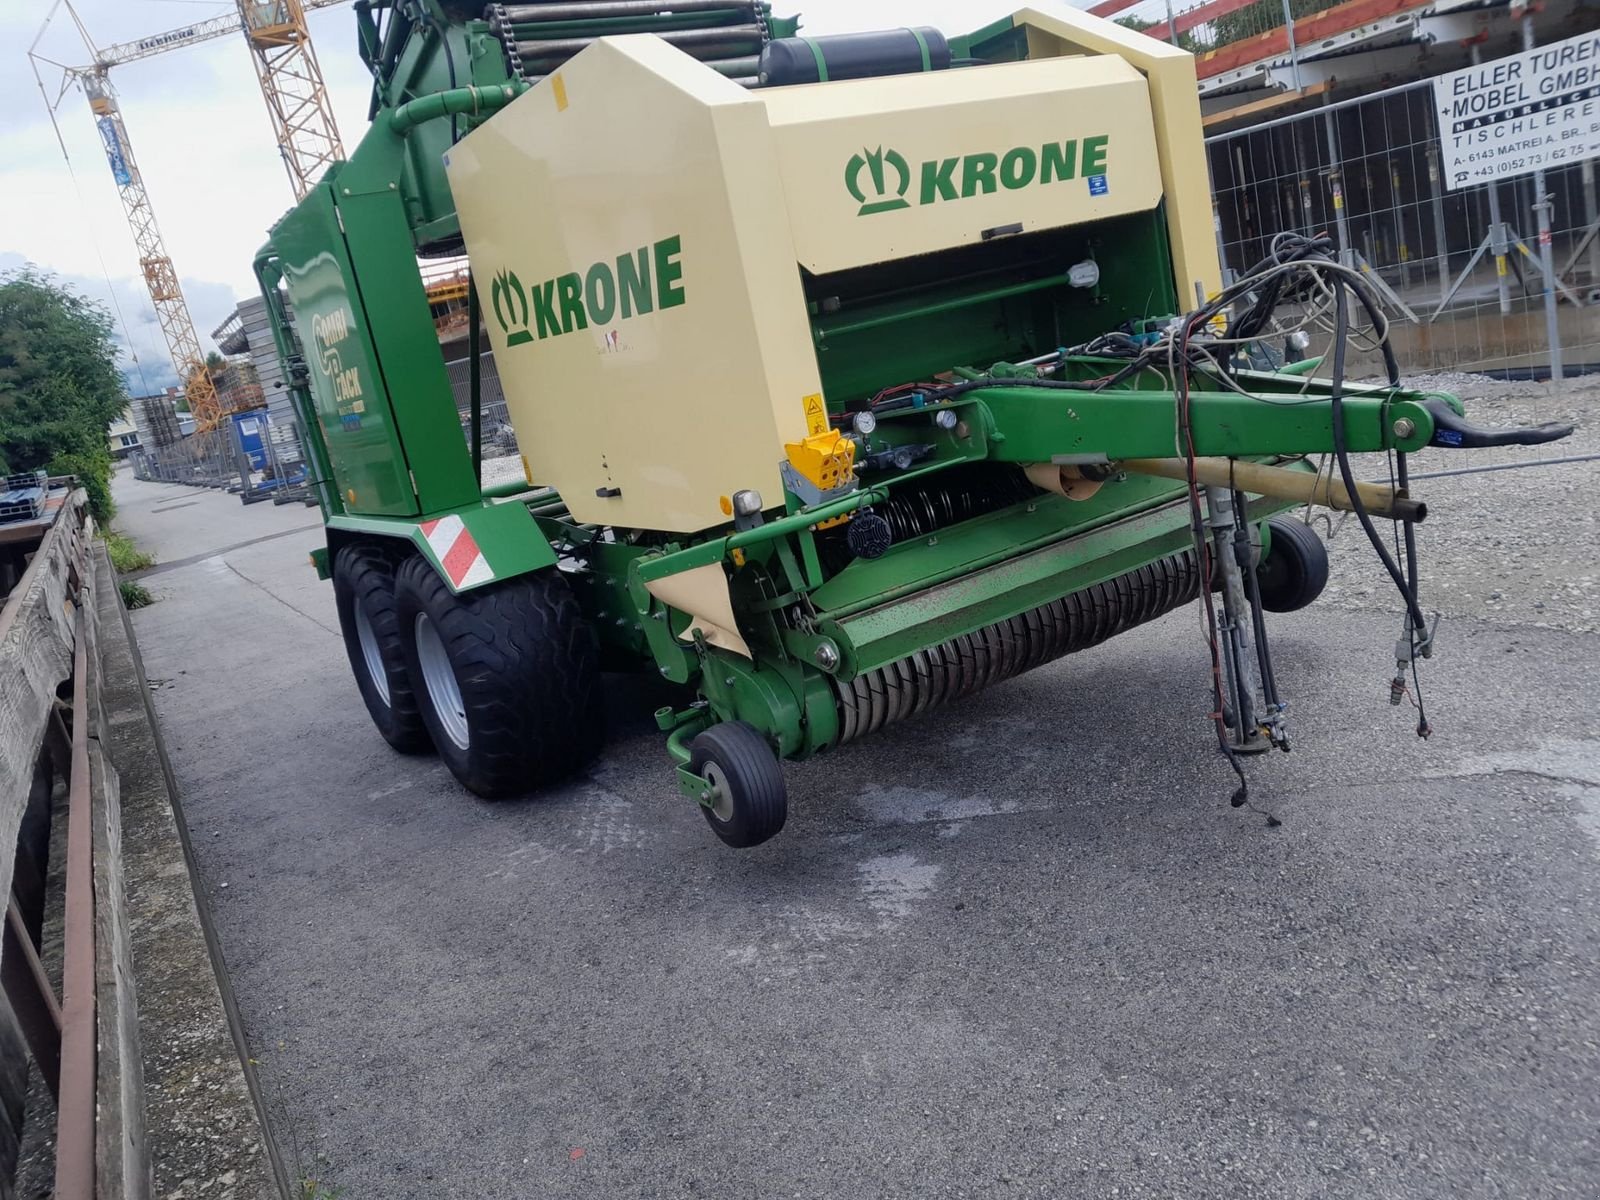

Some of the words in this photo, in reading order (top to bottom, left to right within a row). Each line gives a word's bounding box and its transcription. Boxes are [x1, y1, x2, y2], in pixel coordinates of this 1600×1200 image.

[1453, 61, 1523, 96] ELLER
[1468, 149, 1495, 162] 6143
[1497, 136, 1543, 156] MATREI
[1474, 165, 1494, 177] +43
[1497, 158, 1526, 174] (0)52
[1528, 153, 1543, 165] 73
[1552, 147, 1567, 160] 62
[919, 134, 1110, 206] KRONE
[530, 233, 687, 341] KRONE
